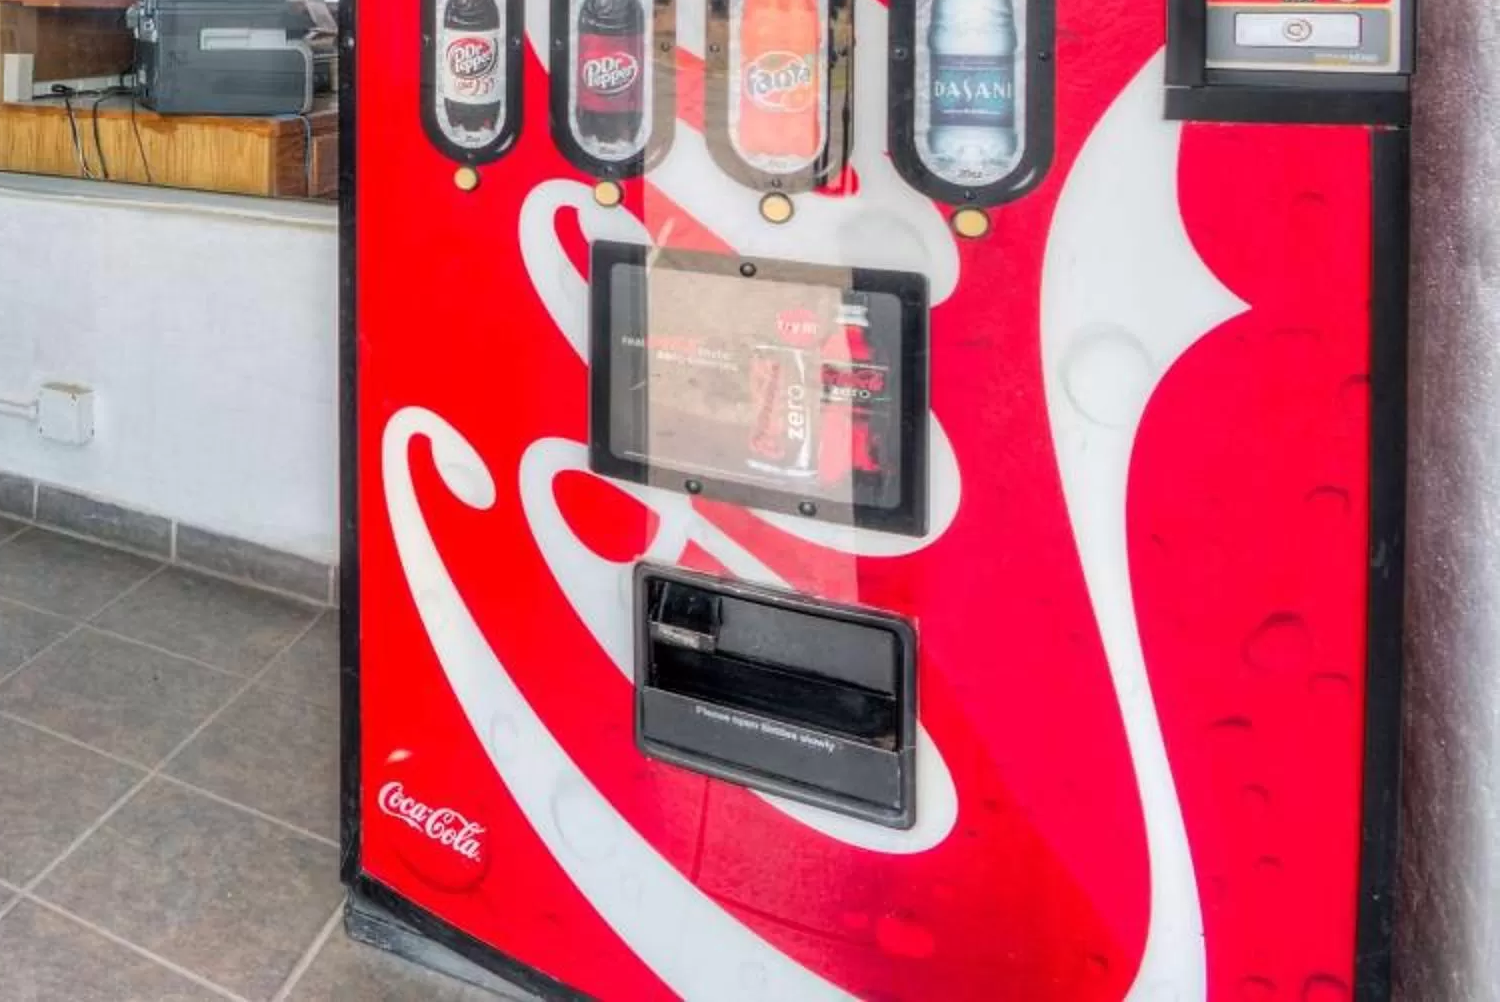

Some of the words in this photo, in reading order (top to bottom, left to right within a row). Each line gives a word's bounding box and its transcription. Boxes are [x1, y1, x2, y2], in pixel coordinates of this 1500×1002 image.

[585, 59, 636, 88] Pepper
[933, 80, 1014, 103] DASANI
[787, 385, 806, 440] zero
[378, 781, 487, 863] Coca-Cola
